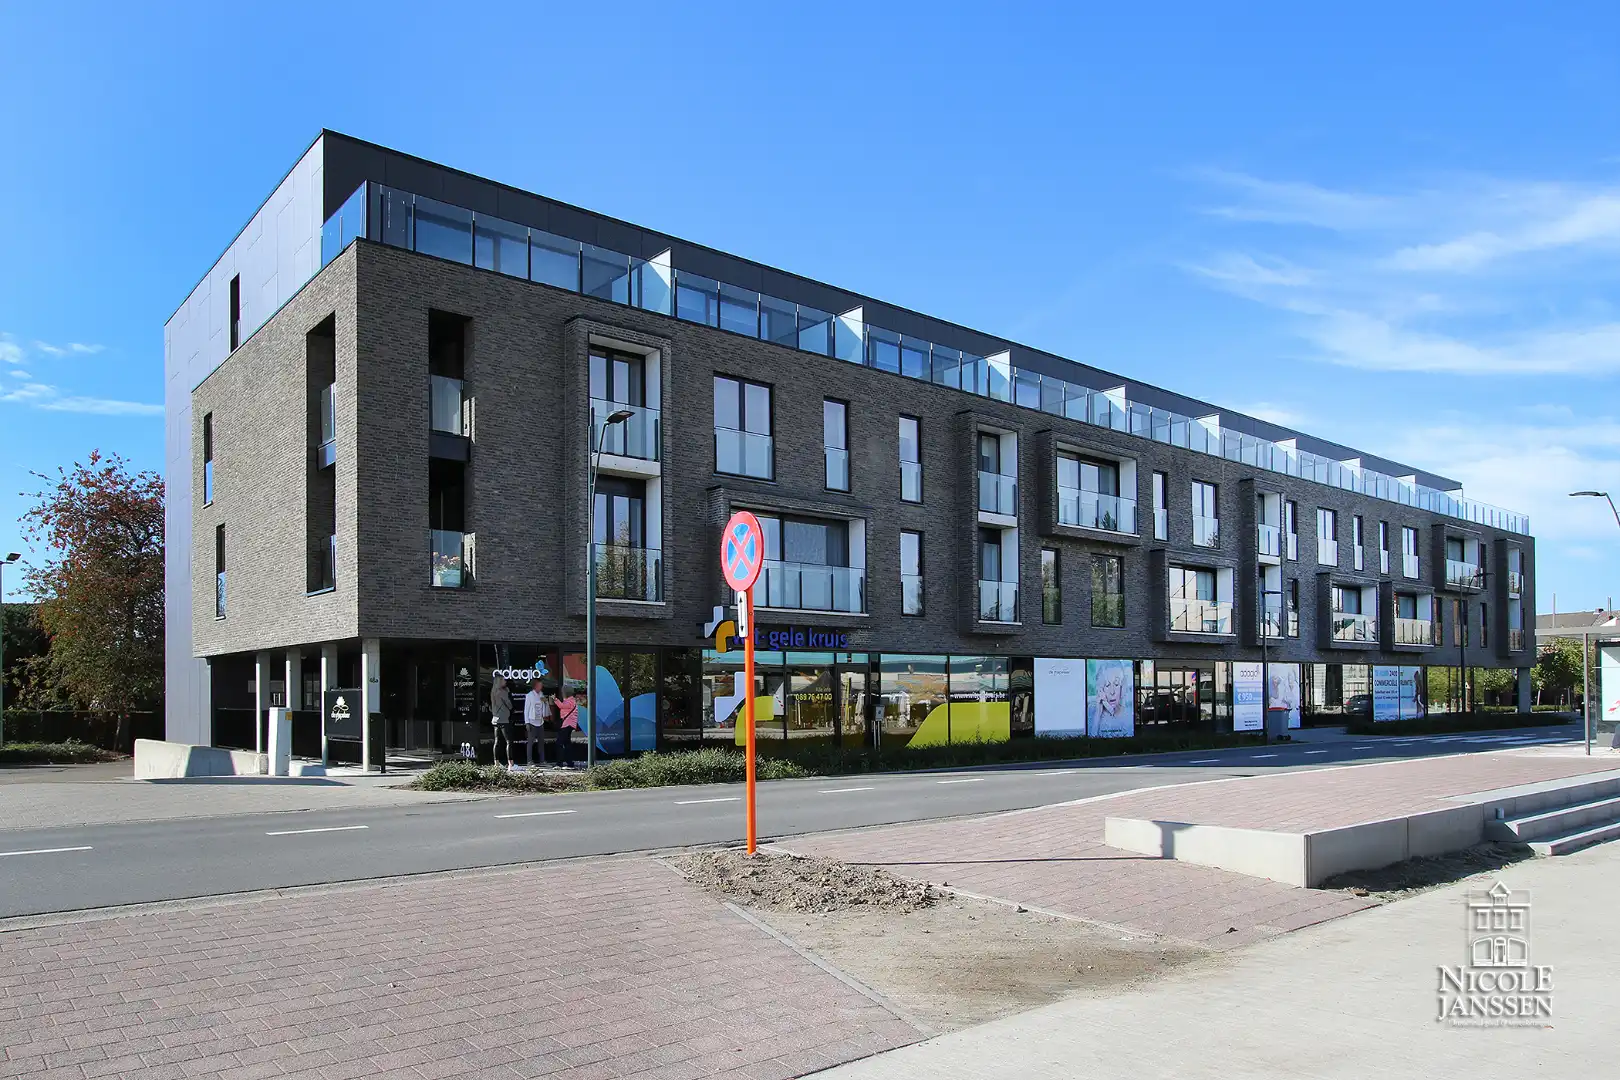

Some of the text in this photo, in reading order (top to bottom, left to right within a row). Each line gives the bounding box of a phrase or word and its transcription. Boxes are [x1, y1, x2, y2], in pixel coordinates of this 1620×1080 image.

[808, 627, 849, 649] kruis
[492, 665, 541, 684] adagio
[460, 742, 475, 758] 48A
